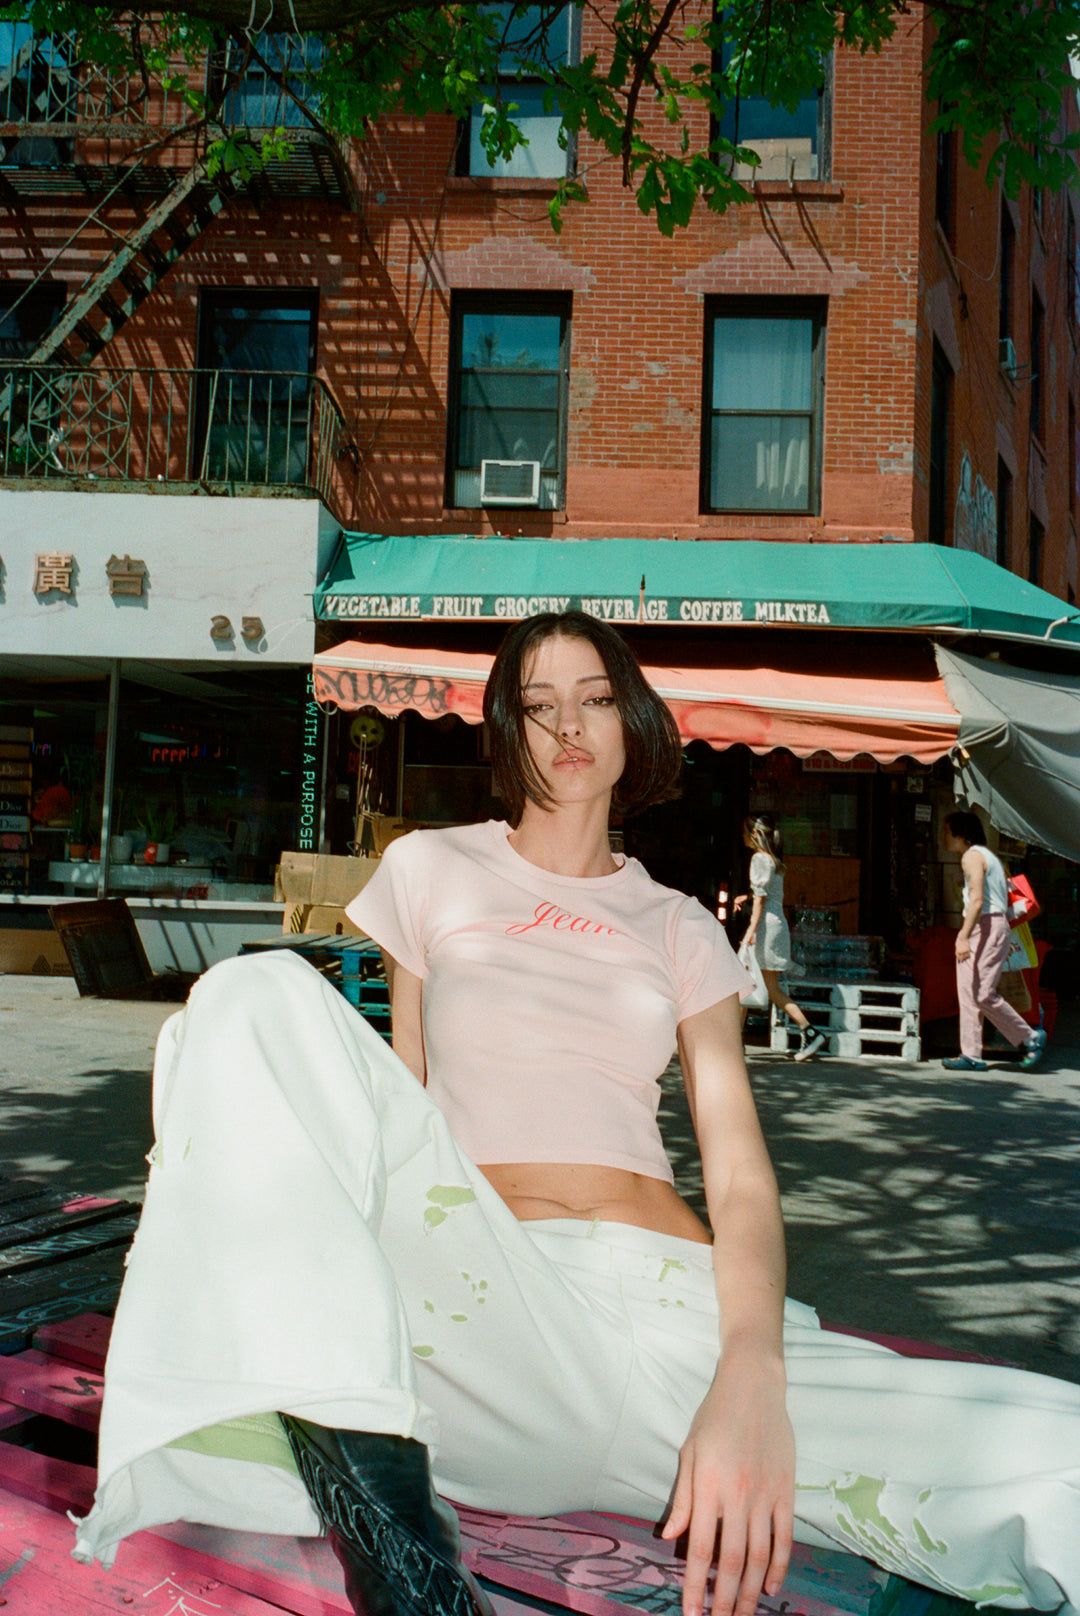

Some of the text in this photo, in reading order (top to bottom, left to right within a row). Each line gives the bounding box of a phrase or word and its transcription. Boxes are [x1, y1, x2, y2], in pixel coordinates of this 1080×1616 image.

[32, 551, 147, 597] 廣告
[326, 595, 830, 623] VEGETABLE FRUIT GROCERY BEVERAGE COFFEE MILKTEA
[304, 700, 318, 747] WITH
[303, 753, 316, 764] A
[300, 771, 316, 849] PURPOSE
